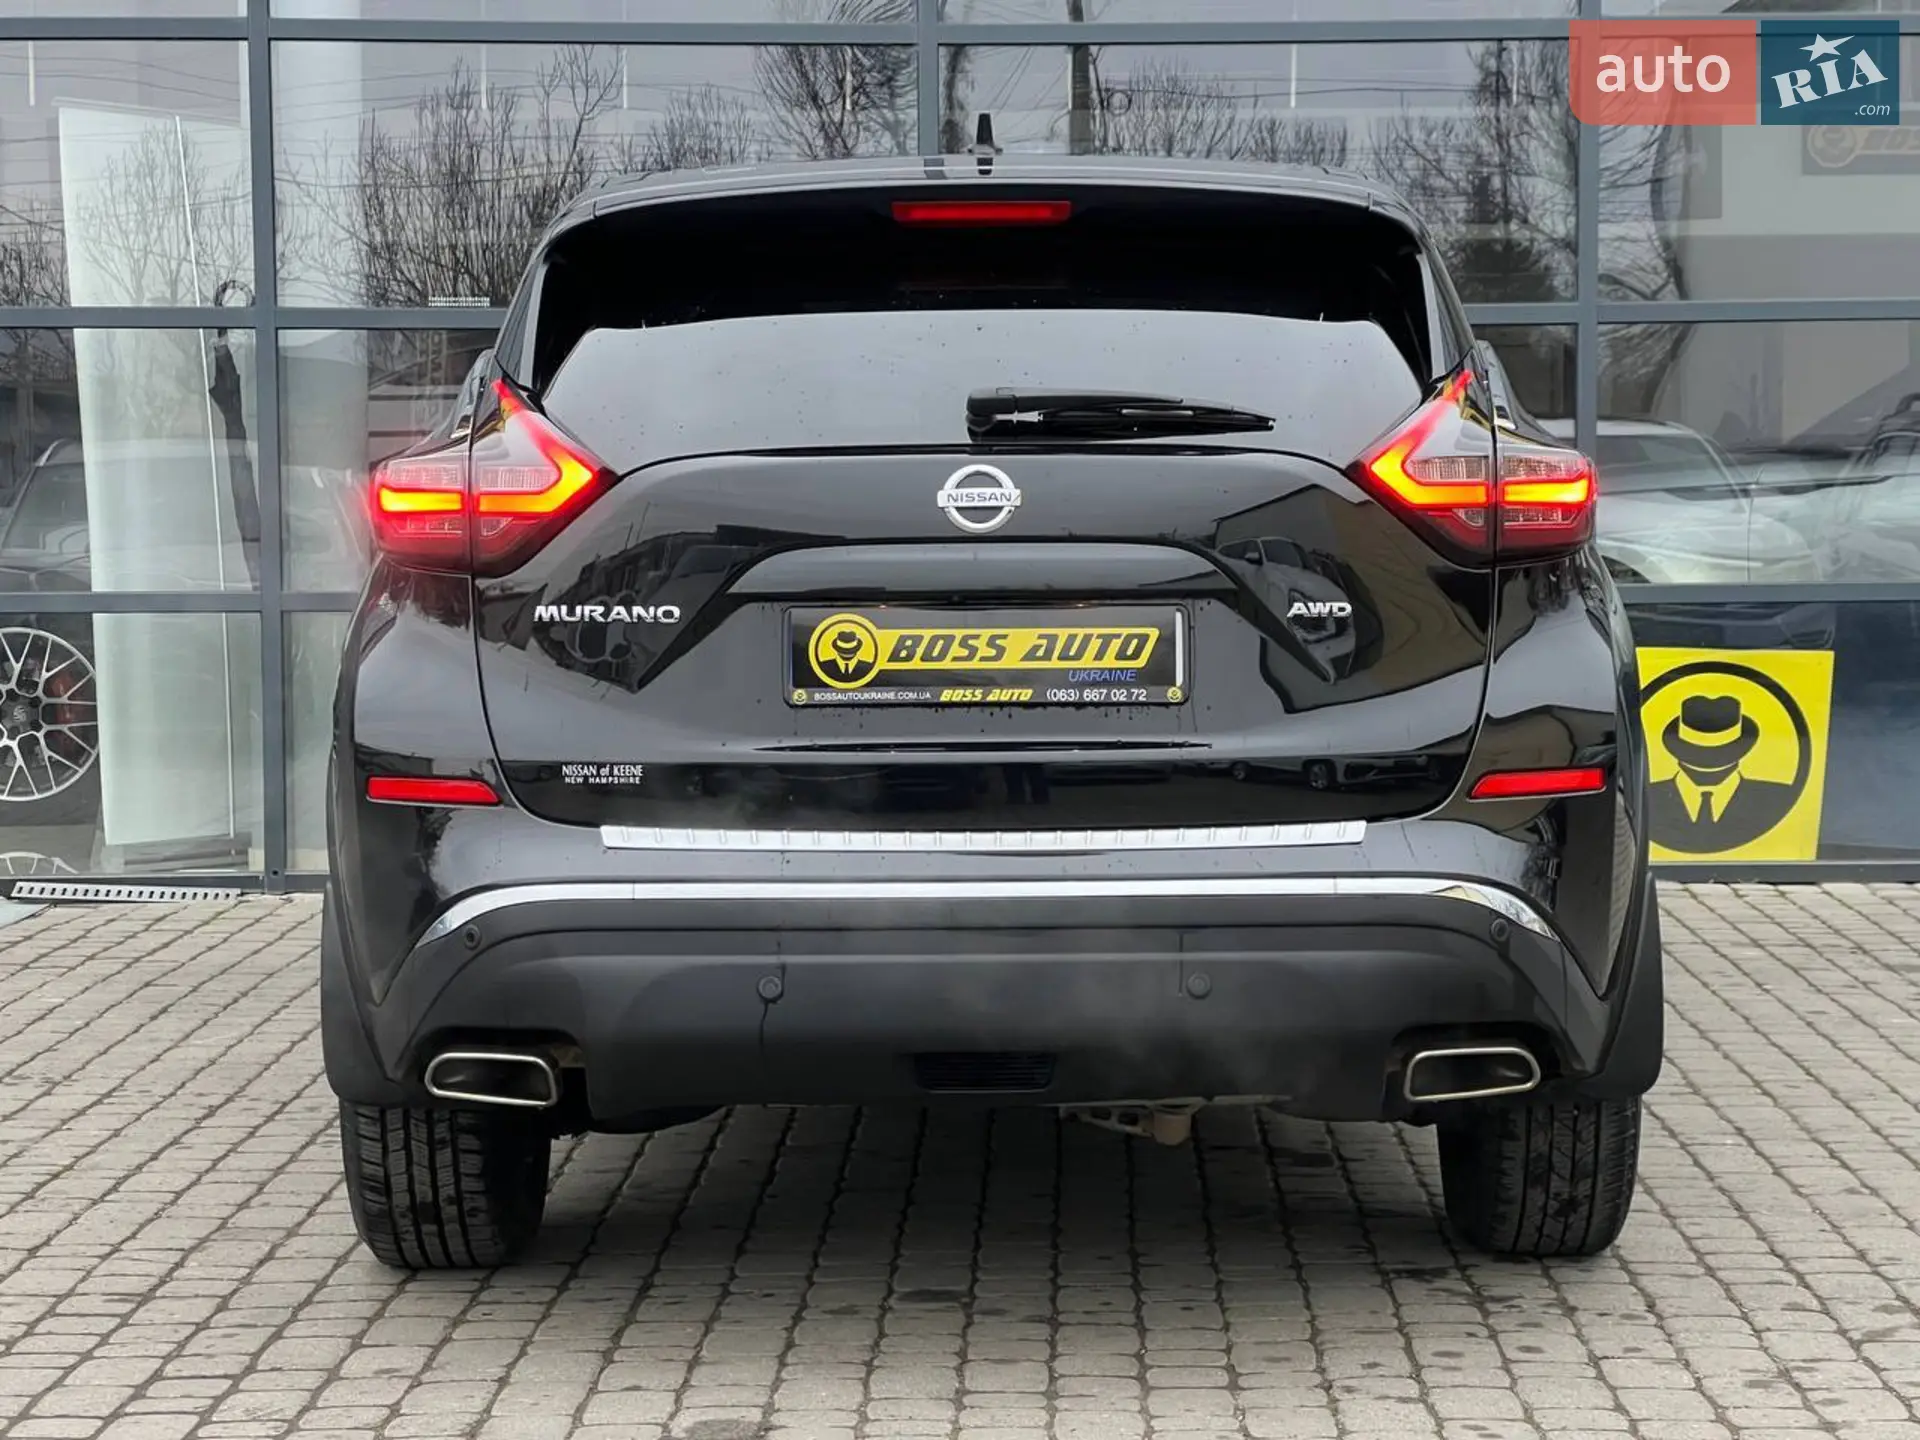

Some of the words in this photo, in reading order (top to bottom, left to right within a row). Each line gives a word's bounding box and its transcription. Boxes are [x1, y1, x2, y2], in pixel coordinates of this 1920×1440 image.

[947, 491, 1012, 503] NISSAN
[534, 604, 681, 623] MURANO
[1286, 602, 1352, 617] AWD
[886, 633, 1009, 662] BOSS
[1019, 633, 1151, 662] AUTO
[1067, 669, 1138, 682] UKRAINE
[940, 688, 984, 702] BOSS
[987, 688, 1033, 701] AUTO
[1046, 688, 1080, 702] (063)
[1083, 688, 1107, 701] 667
[1111, 688, 1128, 701] 02
[1131, 688, 1148, 701] 72
[562, 764, 597, 776] NISSAN
[600, 763, 610, 776] of
[613, 764, 644, 776] KEENE
[564, 776, 585, 784] NEW
[588, 776, 641, 785] HAMPSHIRE
